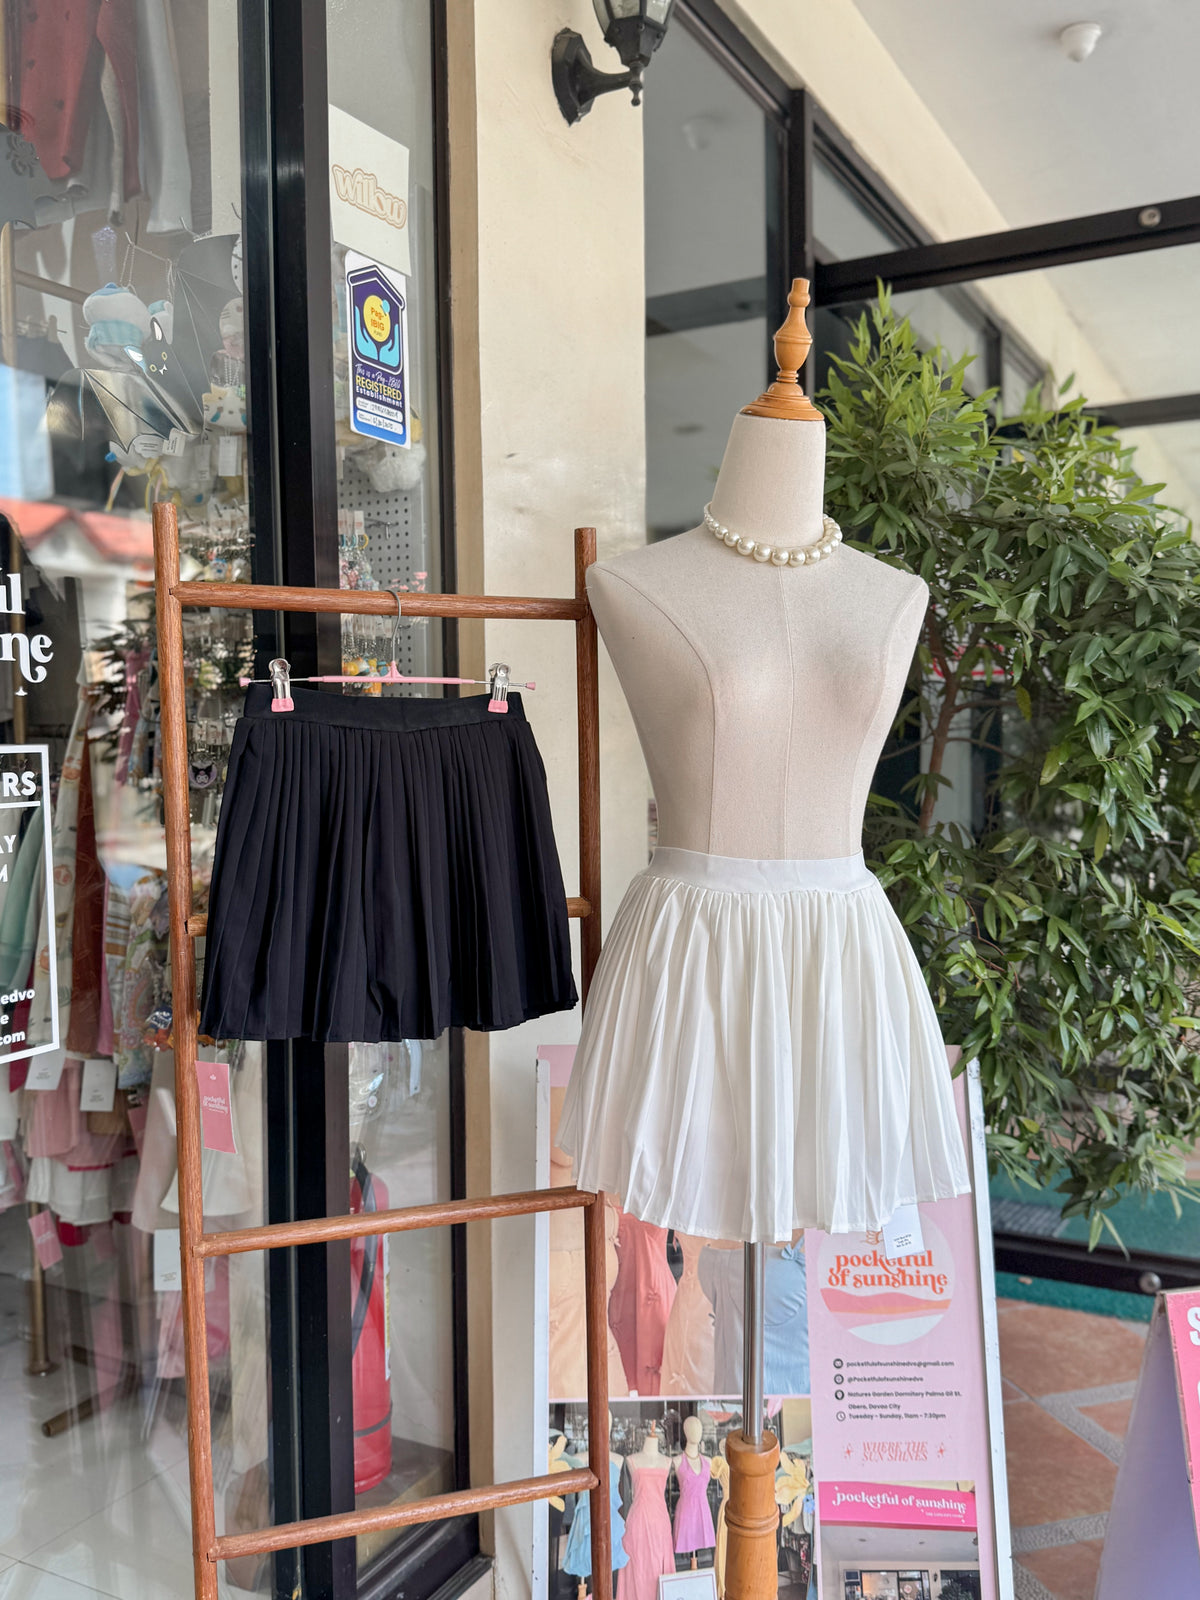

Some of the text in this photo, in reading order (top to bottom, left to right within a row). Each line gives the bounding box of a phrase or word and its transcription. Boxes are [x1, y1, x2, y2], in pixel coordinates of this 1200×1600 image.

[371, 318, 384, 331] IBIG
[356, 375, 402, 401] REGISTERED
[356, 386, 403, 408] Establishment
[2, 771, 37, 797] RS
[0, 989, 36, 1005] edvo
[828, 1267, 948, 1295] of sunshine
[862, 1451, 928, 1462] SUN SHINES
[863, 1440, 928, 1453] WHERE THE
[832, 1490, 966, 1514] pocketful of sunshine
